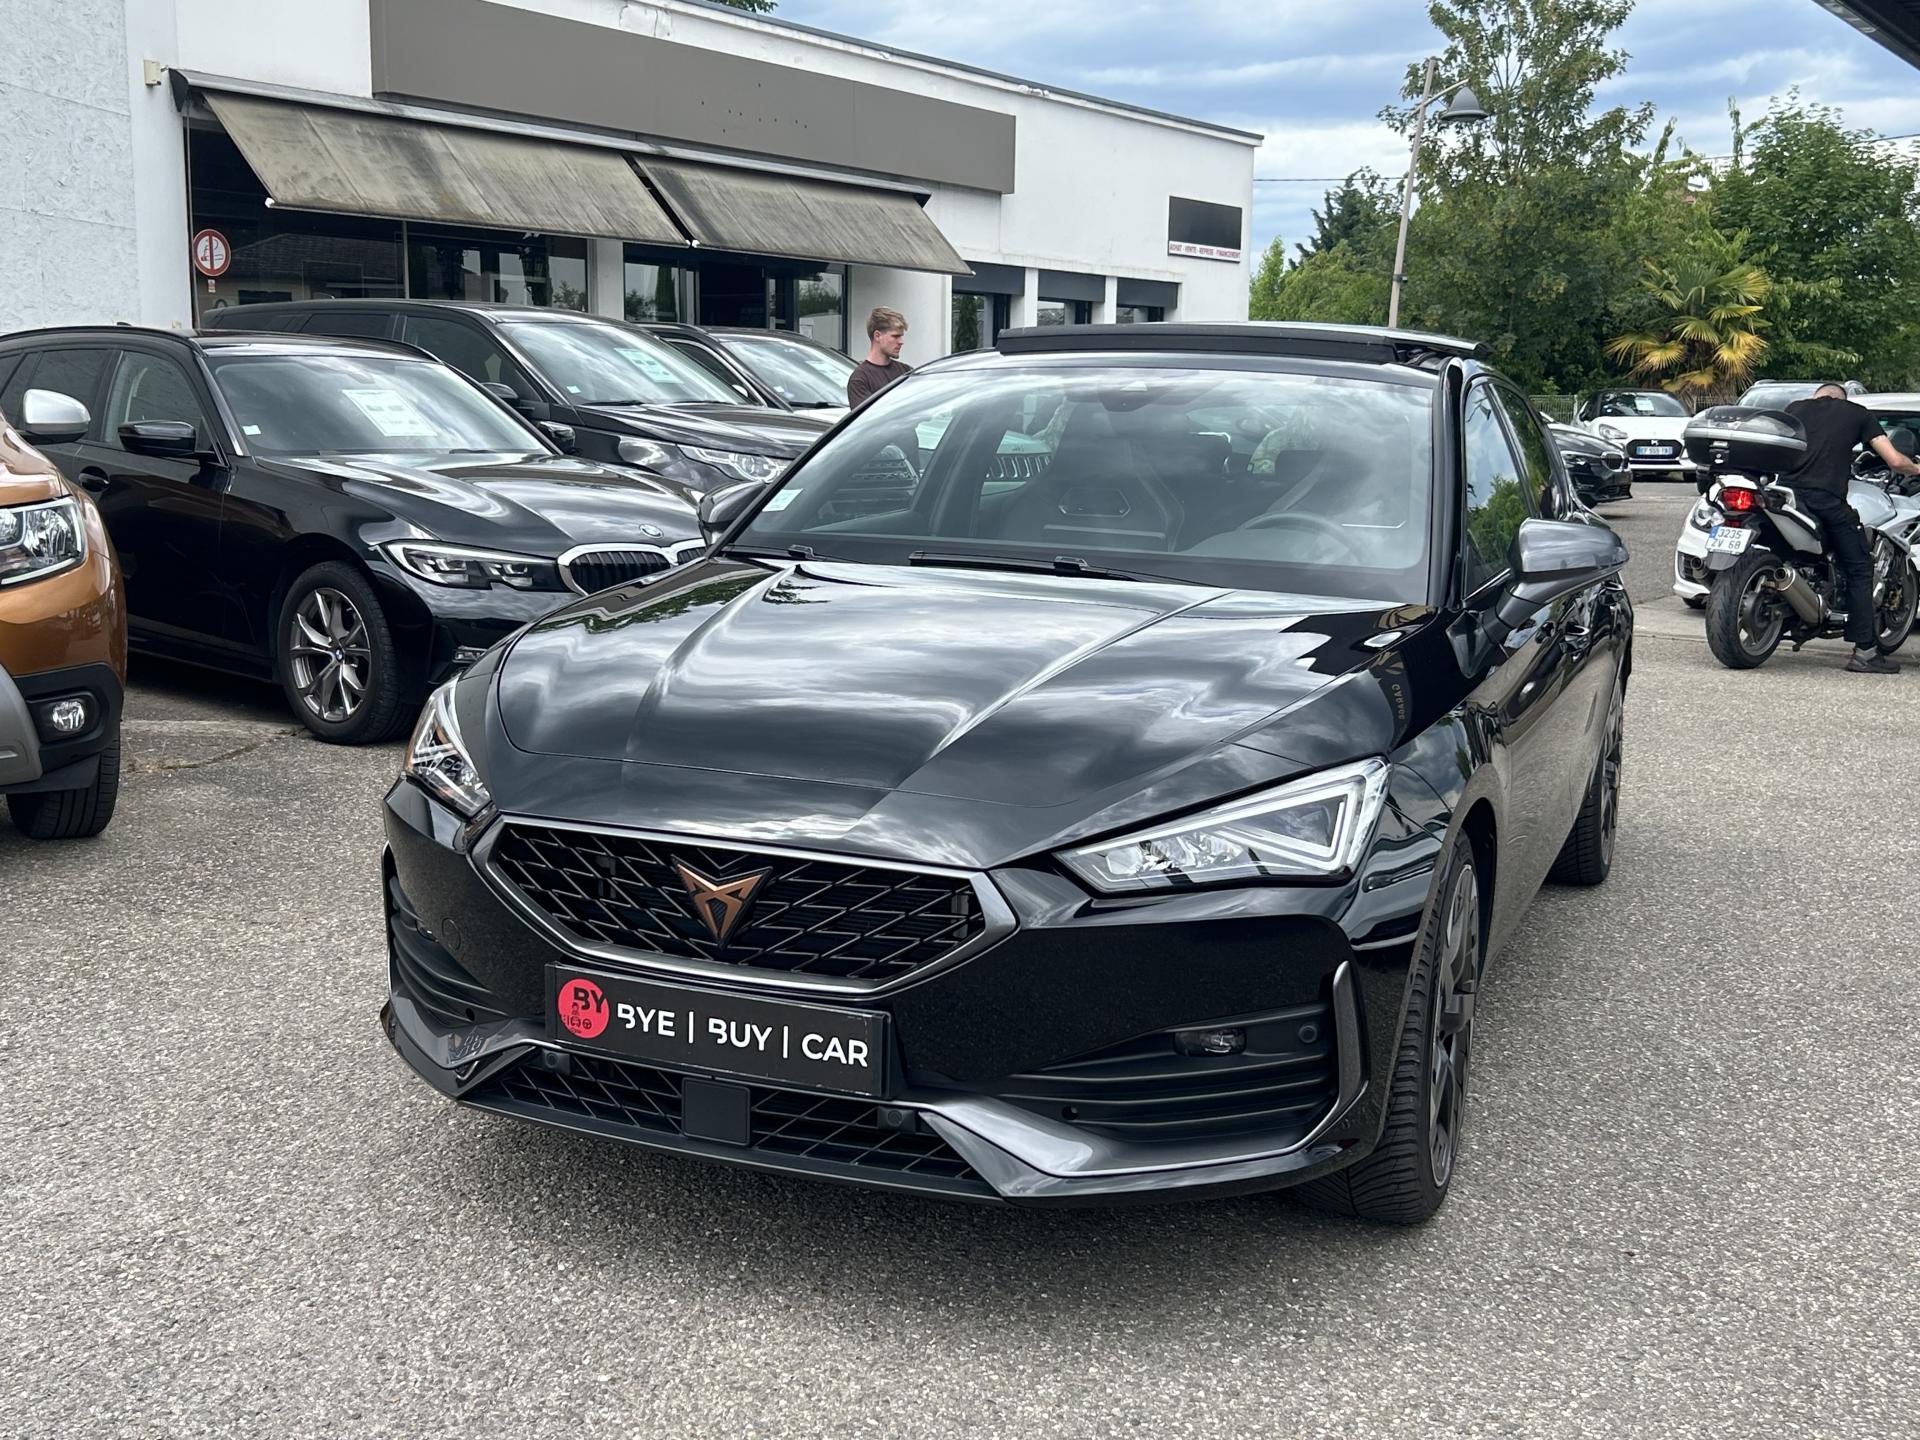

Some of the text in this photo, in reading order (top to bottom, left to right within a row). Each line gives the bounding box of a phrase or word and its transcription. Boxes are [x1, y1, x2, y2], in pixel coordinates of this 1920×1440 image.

[1718, 528, 1743, 539] 3235
[1711, 538, 1741, 549] ZV 68
[573, 986, 605, 1013] BY
[617, 1003, 675, 1038] BYE
[708, 1018, 773, 1051] BUY
[801, 1034, 868, 1068] CAR
